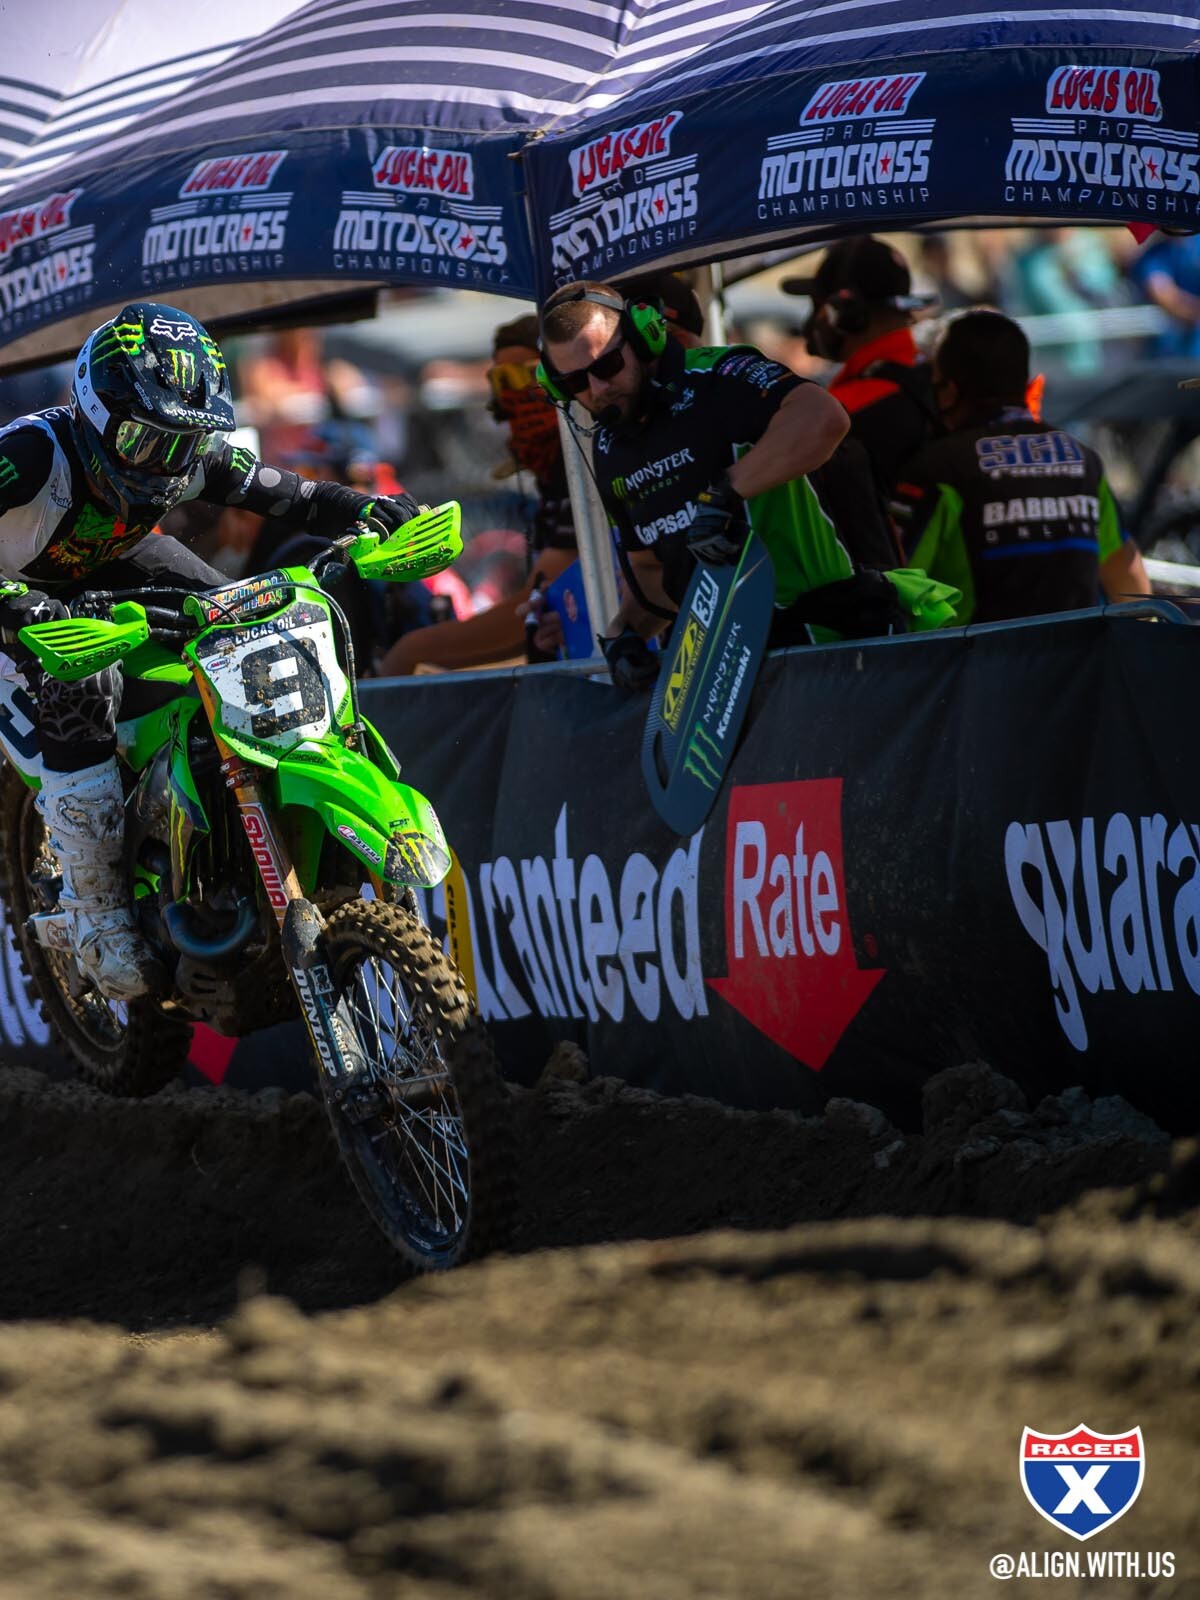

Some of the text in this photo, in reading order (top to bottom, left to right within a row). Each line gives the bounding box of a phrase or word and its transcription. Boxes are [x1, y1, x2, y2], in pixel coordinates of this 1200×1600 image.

[805, 75, 922, 120] LUCAS OIL
[1051, 69, 1159, 116] LUCAS OIL
[825, 123, 872, 141] PRO
[1078, 120, 1128, 137] PRO
[184, 153, 283, 193] LUCAS OIL
[376, 150, 469, 195] LUCAS OIL
[758, 140, 932, 199] MOTOCROSS
[1005, 139, 1200, 195] MOTOCROSS
[551, 173, 699, 270] MOTOCROSS
[757, 188, 929, 219] CHAMPIONSHIP
[142, 211, 289, 266] MOTOCROSS
[333, 210, 507, 265] MOTOCROSS
[167, 407, 231, 426] MONSTER
[625, 448, 695, 491] MONSTER
[234, 615, 297, 645] LUCAS OIL
[240, 637, 326, 738] 9
[702, 621, 741, 724] MONSTER
[716, 646, 751, 740] Kawasaki
[240, 814, 289, 909] SHOWA
[733, 820, 841, 958] Rate
[1004, 812, 1200, 1052] guara
[292, 966, 337, 1077] DUNLOP
